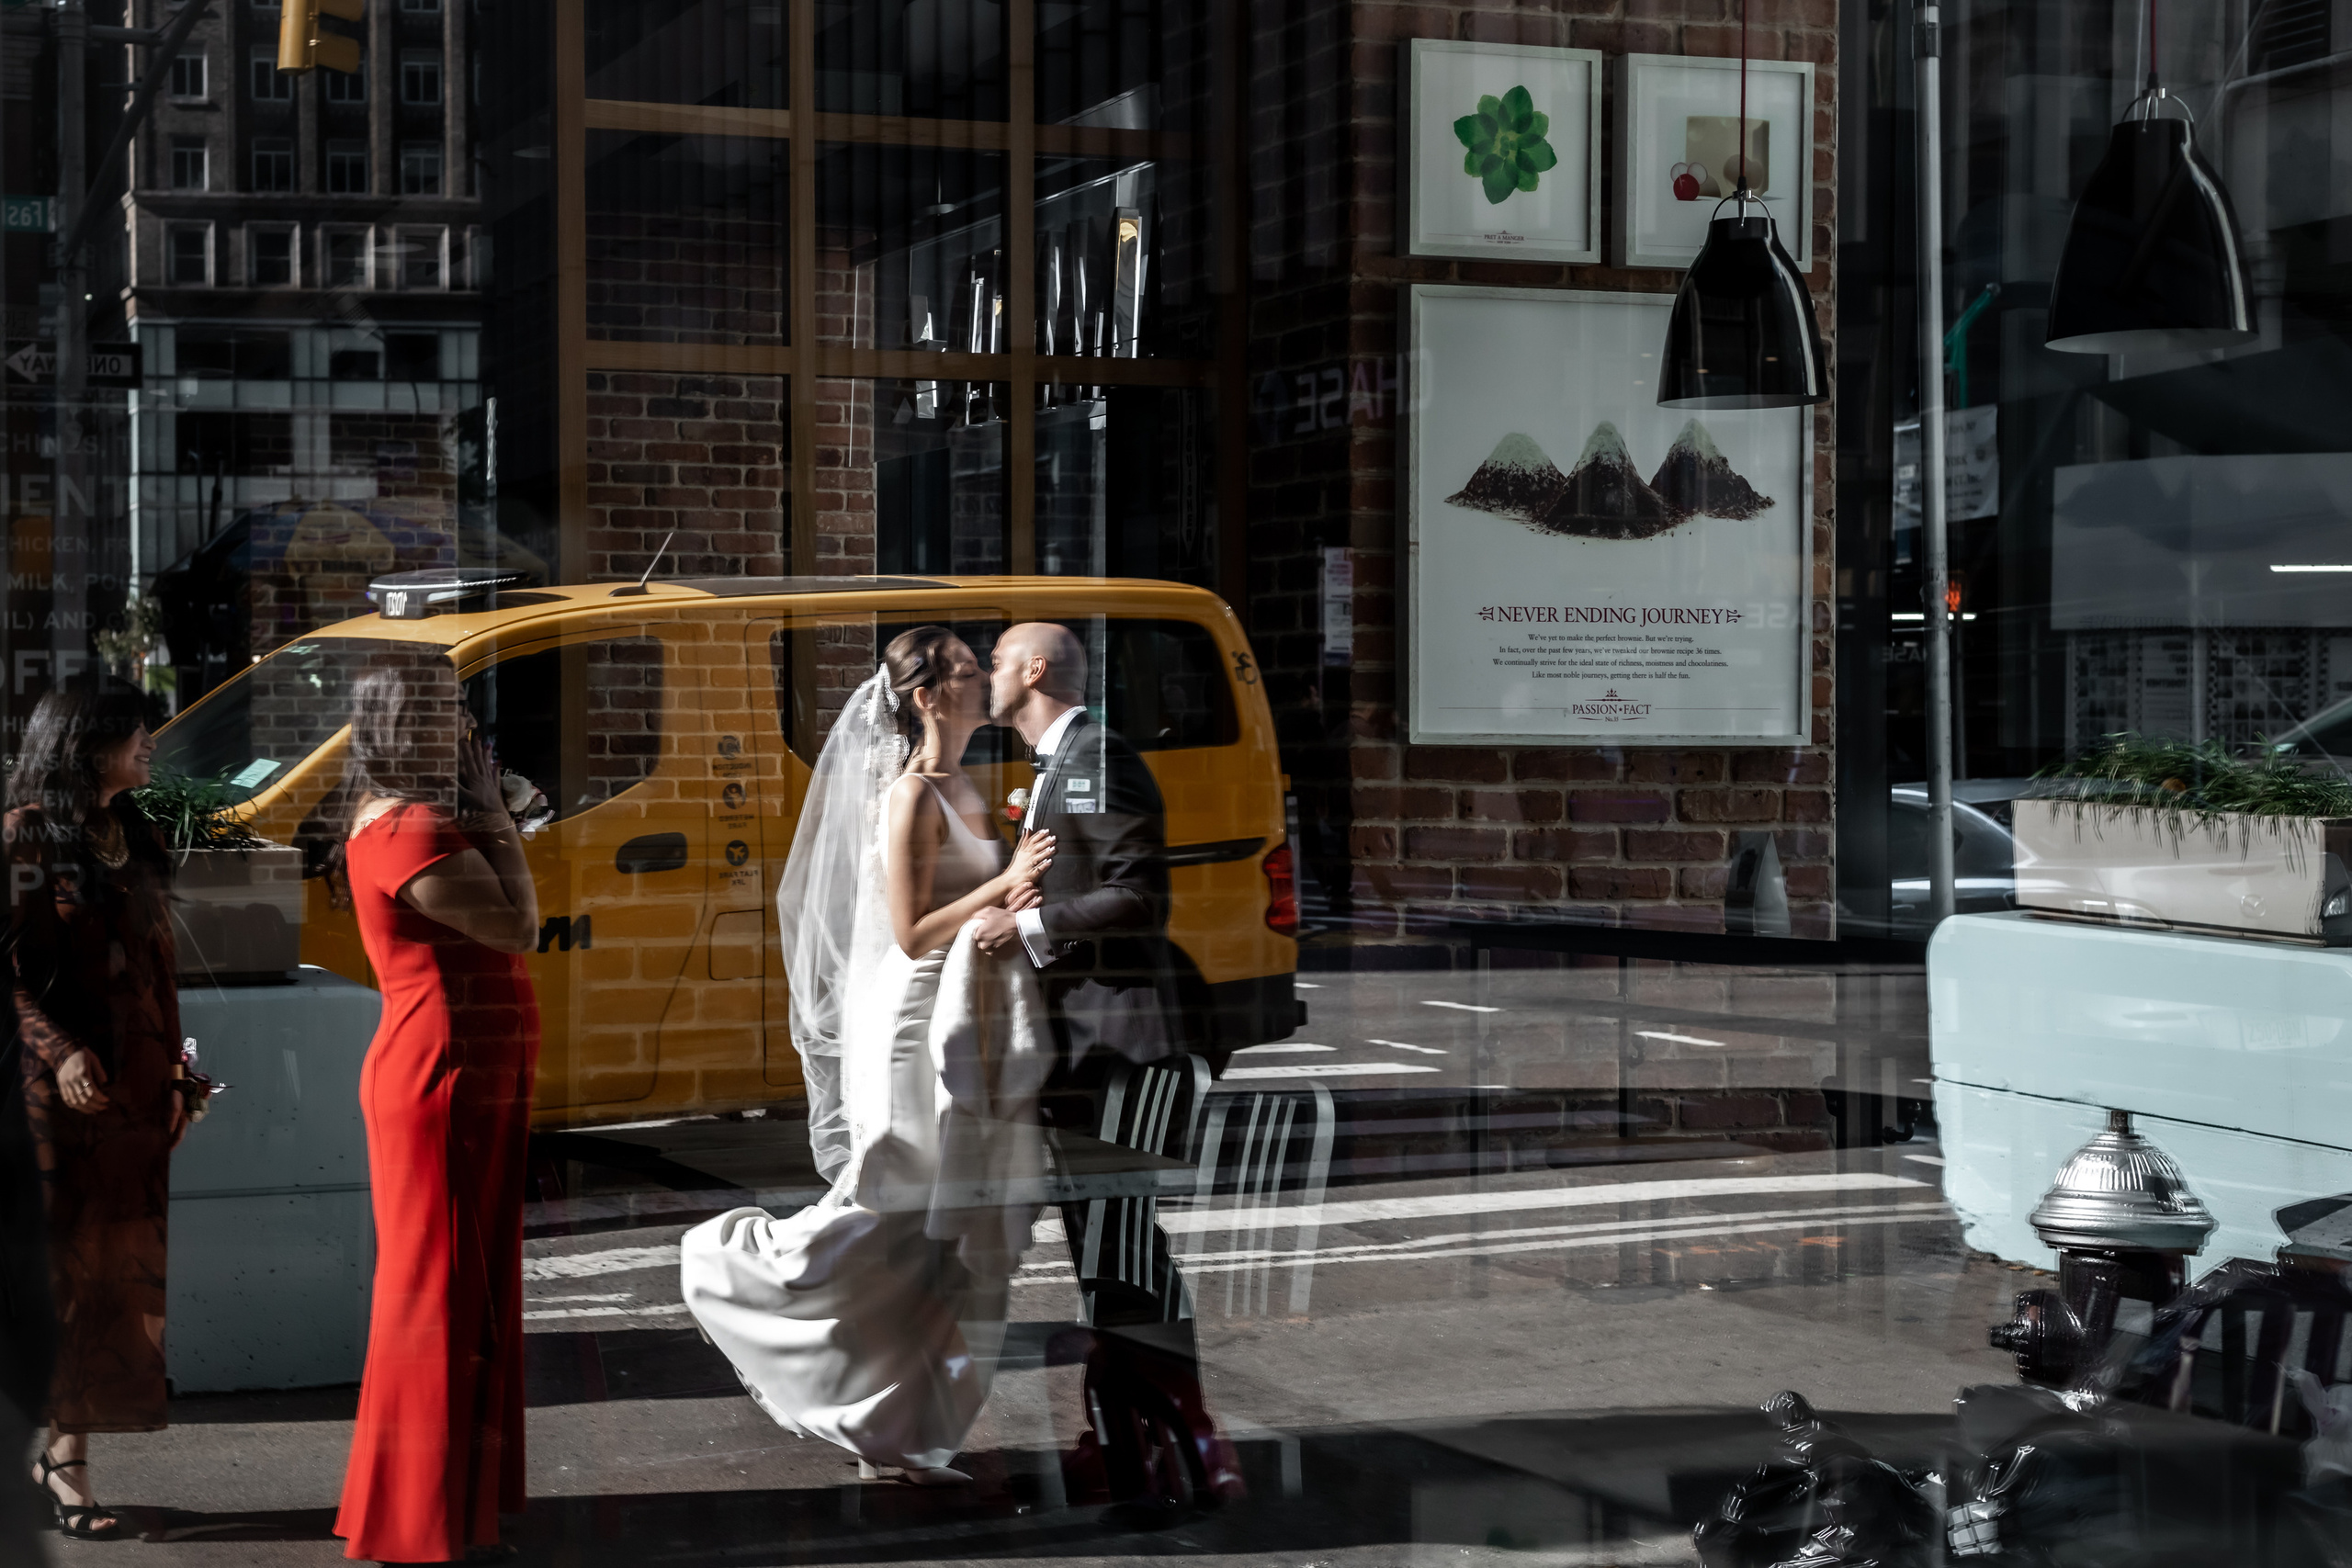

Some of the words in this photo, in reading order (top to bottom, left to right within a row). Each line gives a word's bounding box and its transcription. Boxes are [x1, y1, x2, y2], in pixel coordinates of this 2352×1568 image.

[103, 536, 173, 554] FRSH
[7, 572, 75, 594] MILK,
[0, 610, 35, 630] IL)
[42, 611, 97, 630] AND
[1498, 606, 1559, 623] NEVER
[1564, 606, 1636, 624] ENDING
[1640, 607, 1724, 628] JOURNEY
[1528, 634, 1546, 643] We've
[1548, 634, 1558, 643] yet
[1559, 634, 1565, 643] to
[1566, 634, 1583, 643] make
[1585, 634, 1594, 643] the
[1595, 634, 1616, 643] perfect
[1618, 634, 1644, 643] brownie.
[1645, 634, 1656, 643] But
[1657, 634, 1673, 643] we're
[1675, 634, 1694, 643] trying.
[1499, 646, 1506, 655] In
[1508, 646, 1521, 655] fact,
[1522, 646, 1535, 655] over
[1537, 646, 1546, 655] the
[1548, 646, 1561, 655] past
[1563, 646, 1573, 655] few
[1575, 646, 1592, 655] years,
[1594, 646, 1611, 655] we've
[1612, 646, 1637, 655] tweaked
[1639, 646, 1649, 655] our
[1651, 646, 1675, 655] brownie
[1677, 646, 1694, 655] recipe
[1695, 646, 1703, 655] 36
[1704, 646, 1722, 655] times.
[1493, 658, 1503, 667] We
[1504, 658, 1538, 667] continually
[1540, 658, 1556, 667] strive
[1558, 658, 1566, 667] for
[1568, 658, 1577, 667] the
[1579, 658, 1593, 667] ideal
[1595, 658, 1609, 667] state
[1611, 658, 1618, 667] of
[1619, 658, 1644, 667] richness,
[1645, 658, 1674, 667] moistness
[1676, 658, 1686, 667] and
[1688, 658, 1728, 667] chocolatiness.
[1532, 671, 1545, 680] Like
[1547, 671, 1562, 680] most
[1564, 671, 1580, 680] noble
[1582, 671, 1609, 680] journeys,
[1611, 671, 1631, 680] getting
[1632, 671, 1646, 680] there
[1648, 671, 1654, 680] is
[1655, 671, 1667, 680] half
[1668, 671, 1677, 680] the
[1679, 671, 1690, 680] fun.
[1572, 704, 1618, 715] PASSION
[1623, 704, 1652, 715] FACT
